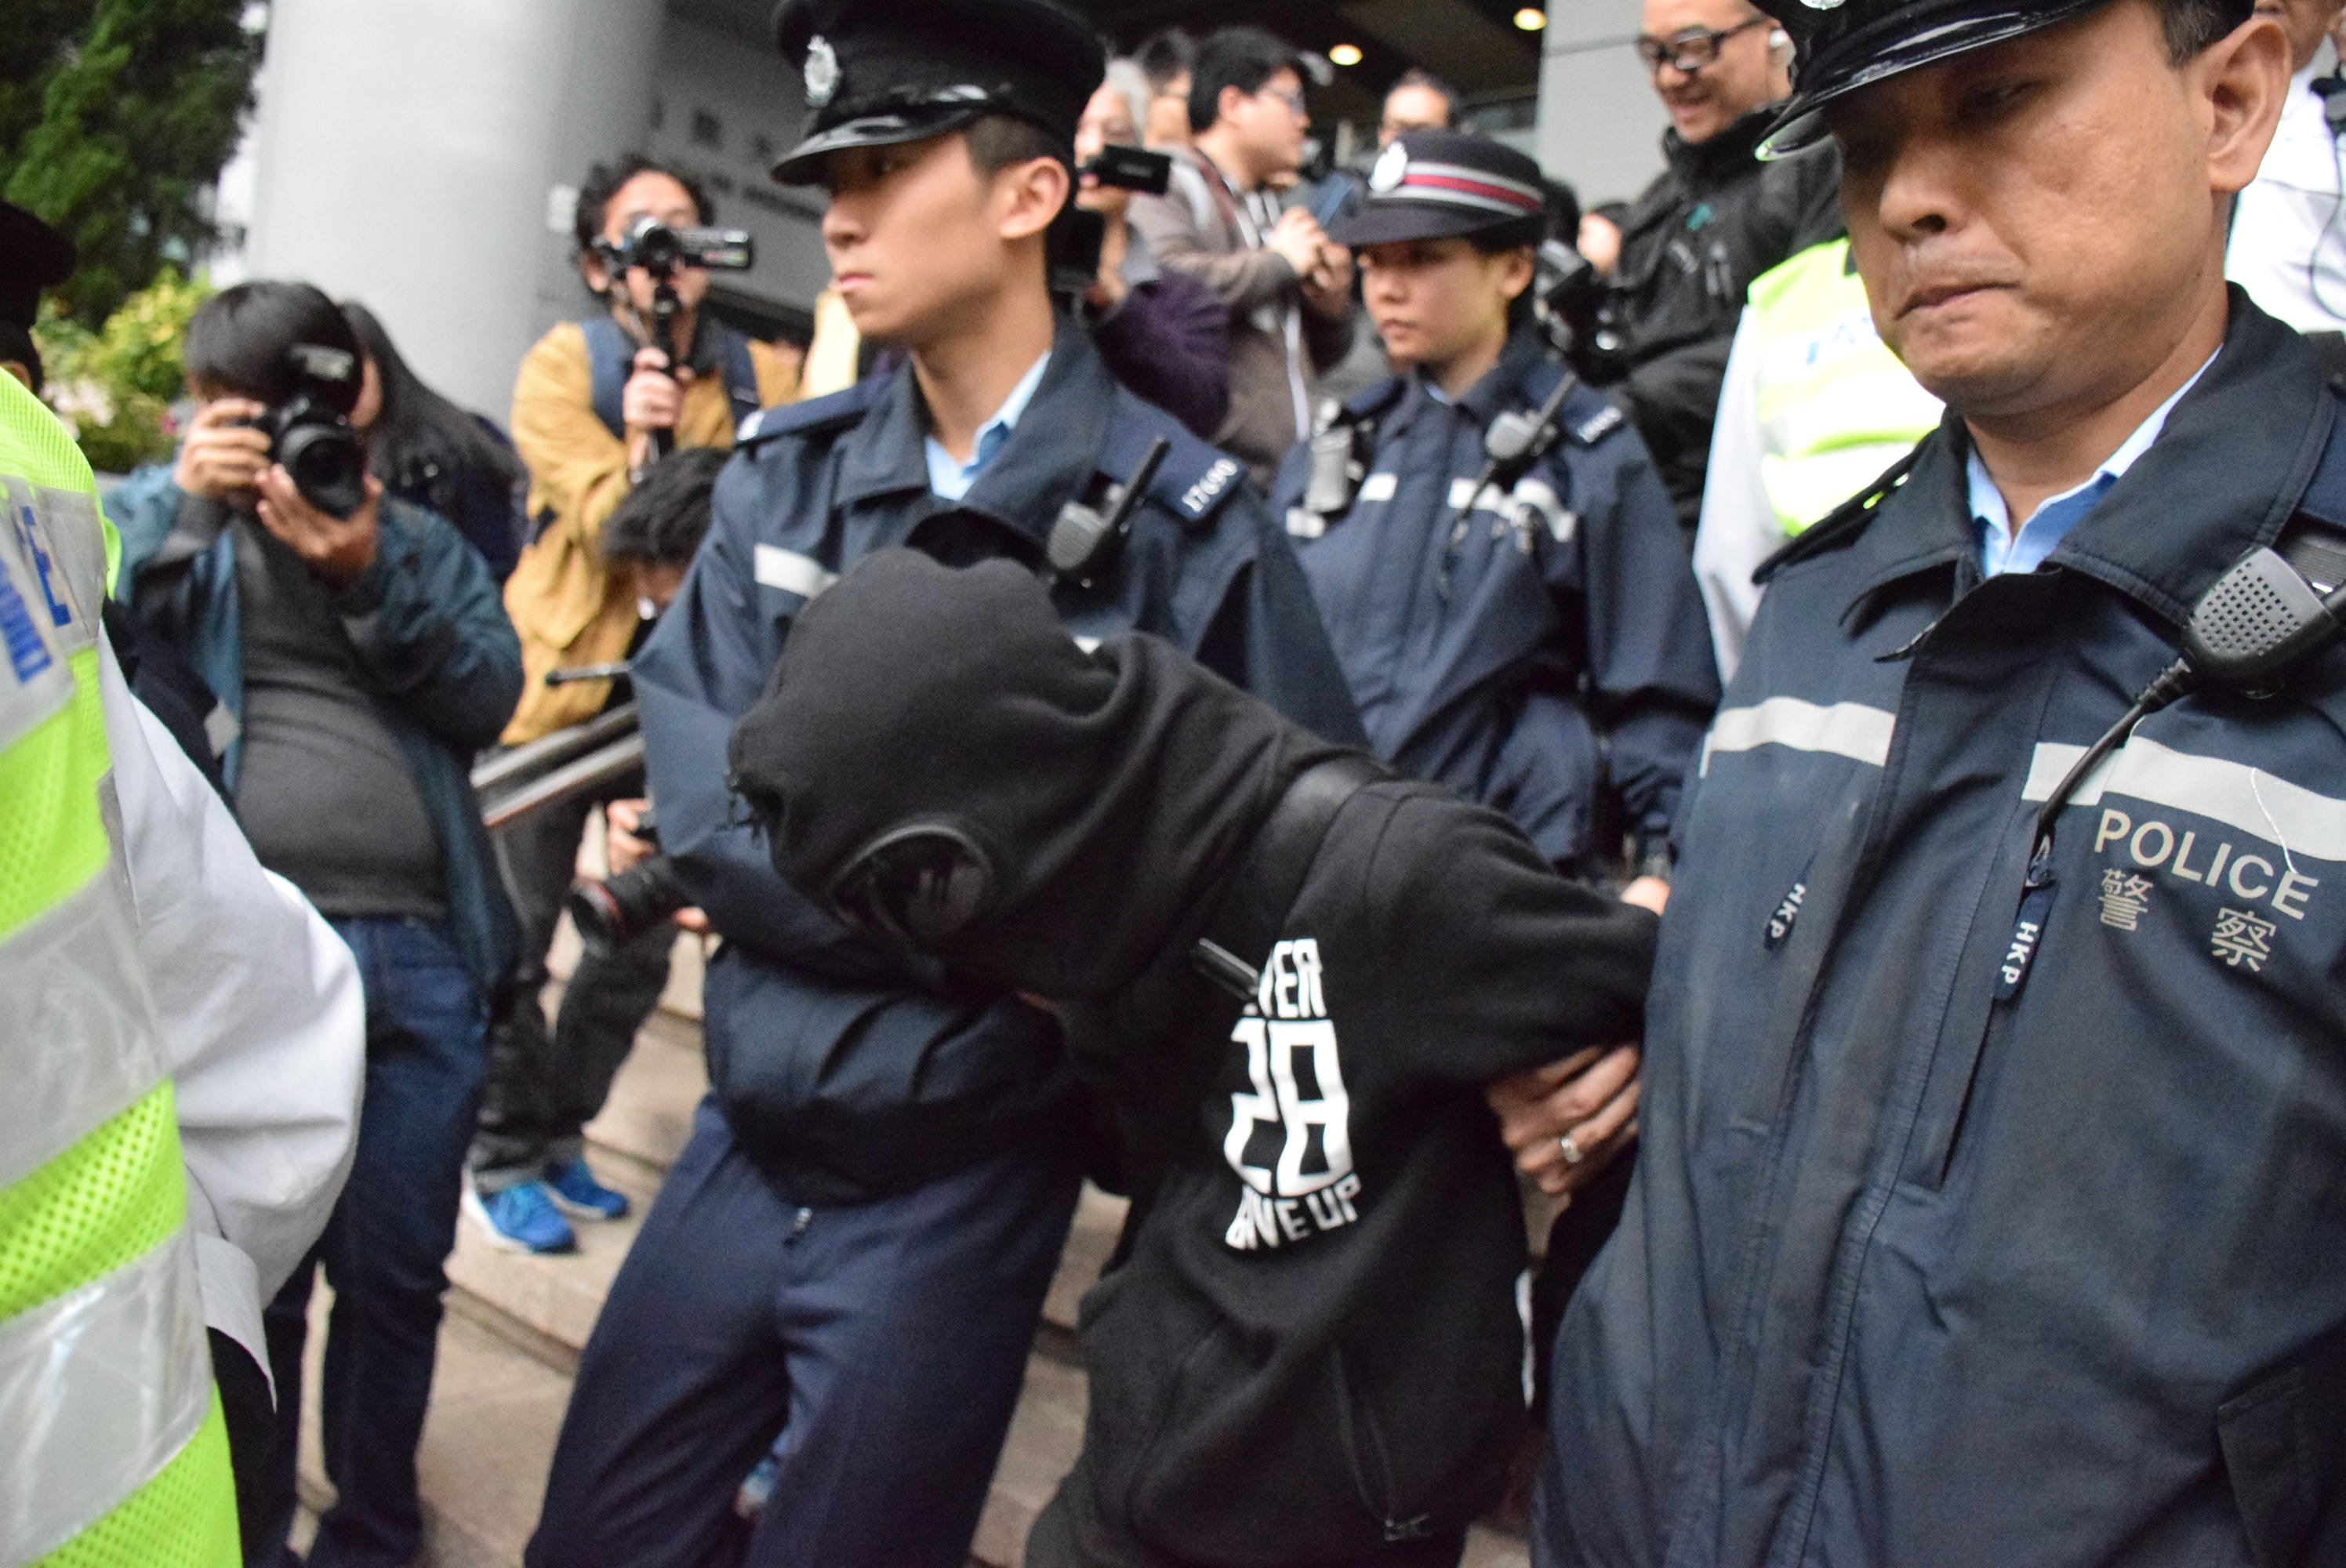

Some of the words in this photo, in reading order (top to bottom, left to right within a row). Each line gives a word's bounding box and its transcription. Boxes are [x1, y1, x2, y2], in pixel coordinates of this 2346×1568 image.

[2094, 808, 2319, 920] POLICE
[1770, 884, 1806, 938] HKP
[2001, 920, 2039, 984] HKP
[2098, 868, 2277, 972] 警察
[1223, 1017, 1353, 1197] 28
[1304, 1172, 1362, 1231] UP
